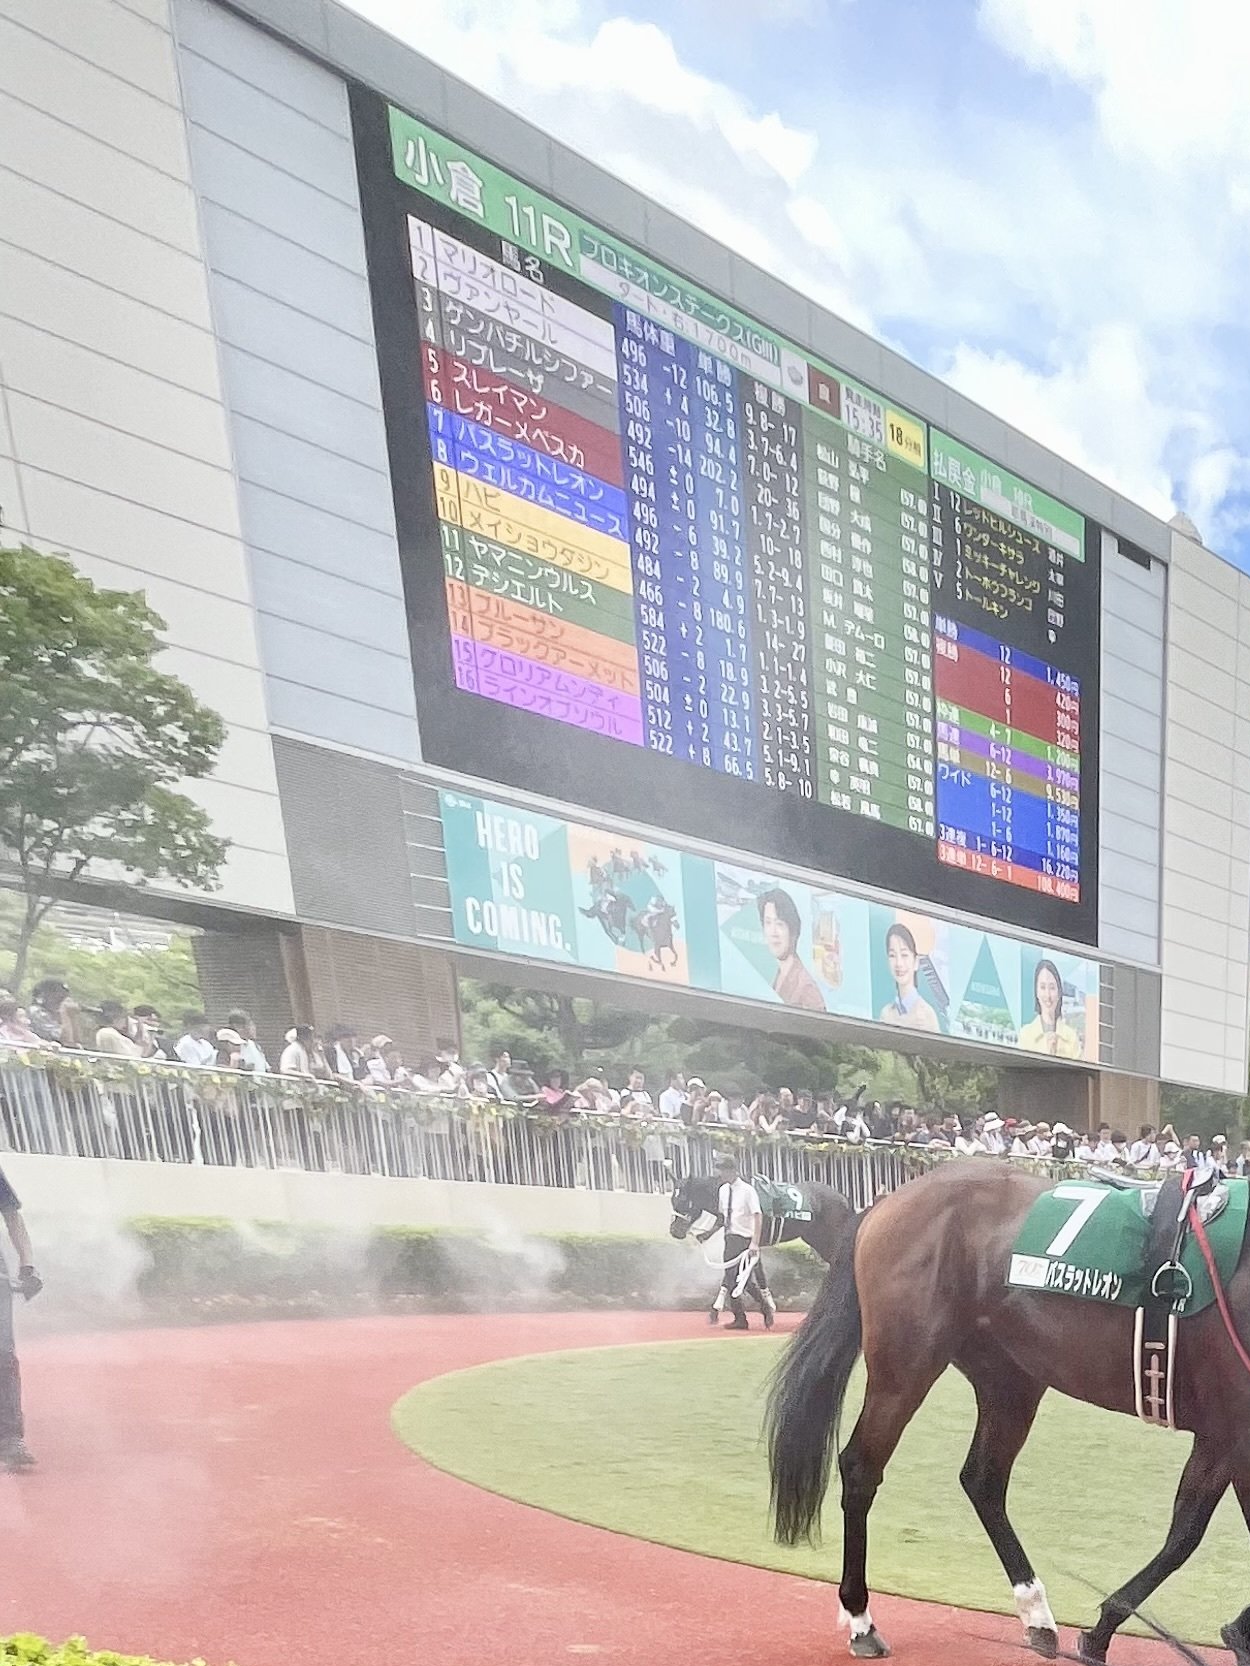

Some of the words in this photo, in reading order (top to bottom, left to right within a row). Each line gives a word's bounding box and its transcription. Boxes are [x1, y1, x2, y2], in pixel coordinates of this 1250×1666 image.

[402, 135, 486, 219] 小倉
[503, 188, 573, 269] 11R
[501, 238, 544, 286] 馬名
[414, 223, 428, 253] 1
[620, 334, 647, 369] 496
[662, 357, 687, 390] -12
[417, 254, 431, 284] 2
[622, 362, 649, 396] 534
[420, 286, 434, 315] 3
[624, 390, 650, 424] 506
[666, 411, 690, 443] -10
[423, 317, 437, 346] 4
[626, 418, 652, 450] 492
[668, 438, 692, 470] -14
[426, 347, 440, 376] 5
[452, 359, 548, 427] スレイマン
[628, 445, 654, 477] 546
[429, 378, 443, 406] 6
[630, 472, 656, 503] 494
[846, 403, 882, 443] 15:35
[432, 408, 445, 435] 7
[632, 499, 658, 530] 496
[435, 437, 448, 465] 8
[634, 525, 660, 555] 492
[933, 446, 975, 496] 払戻金
[438, 467, 451, 494] 9
[636, 551, 661, 581] 484
[950, 489, 960, 513] 12
[954, 514, 961, 535] 6
[441, 496, 458, 524] 10
[638, 577, 663, 607] 466
[444, 525, 461, 553] 11
[469, 535, 596, 605] ヤマニンウルス
[640, 603, 665, 632] 584
[955, 537, 960, 557] 1
[955, 558, 962, 579] 2
[446, 554, 464, 581] 12
[642, 629, 667, 657] 522
[955, 579, 962, 601] 5
[449, 582, 466, 609] 13
[644, 654, 668, 682] 506
[452, 610, 469, 636] 14
[646, 679, 670, 706] 504
[999, 643, 1010, 666] 12
[455, 638, 472, 664] 15
[648, 704, 672, 730] 512
[1000, 664, 1011, 686] 12
[1004, 686, 1011, 706] 6
[458, 665, 475, 691] 16
[650, 729, 673, 755] 522
[1005, 707, 1010, 725] 1
[938, 761, 971, 790] ワイド
[990, 781, 1011, 804] 6-12
[991, 801, 1012, 824] 1-12
[475, 811, 540, 861] HERO
[500, 860, 525, 900] IS
[465, 896, 572, 951] COMING.
[1046, 1185, 1111, 1257] 7
[1047, 1260, 1123, 1301] バスラットレオン
